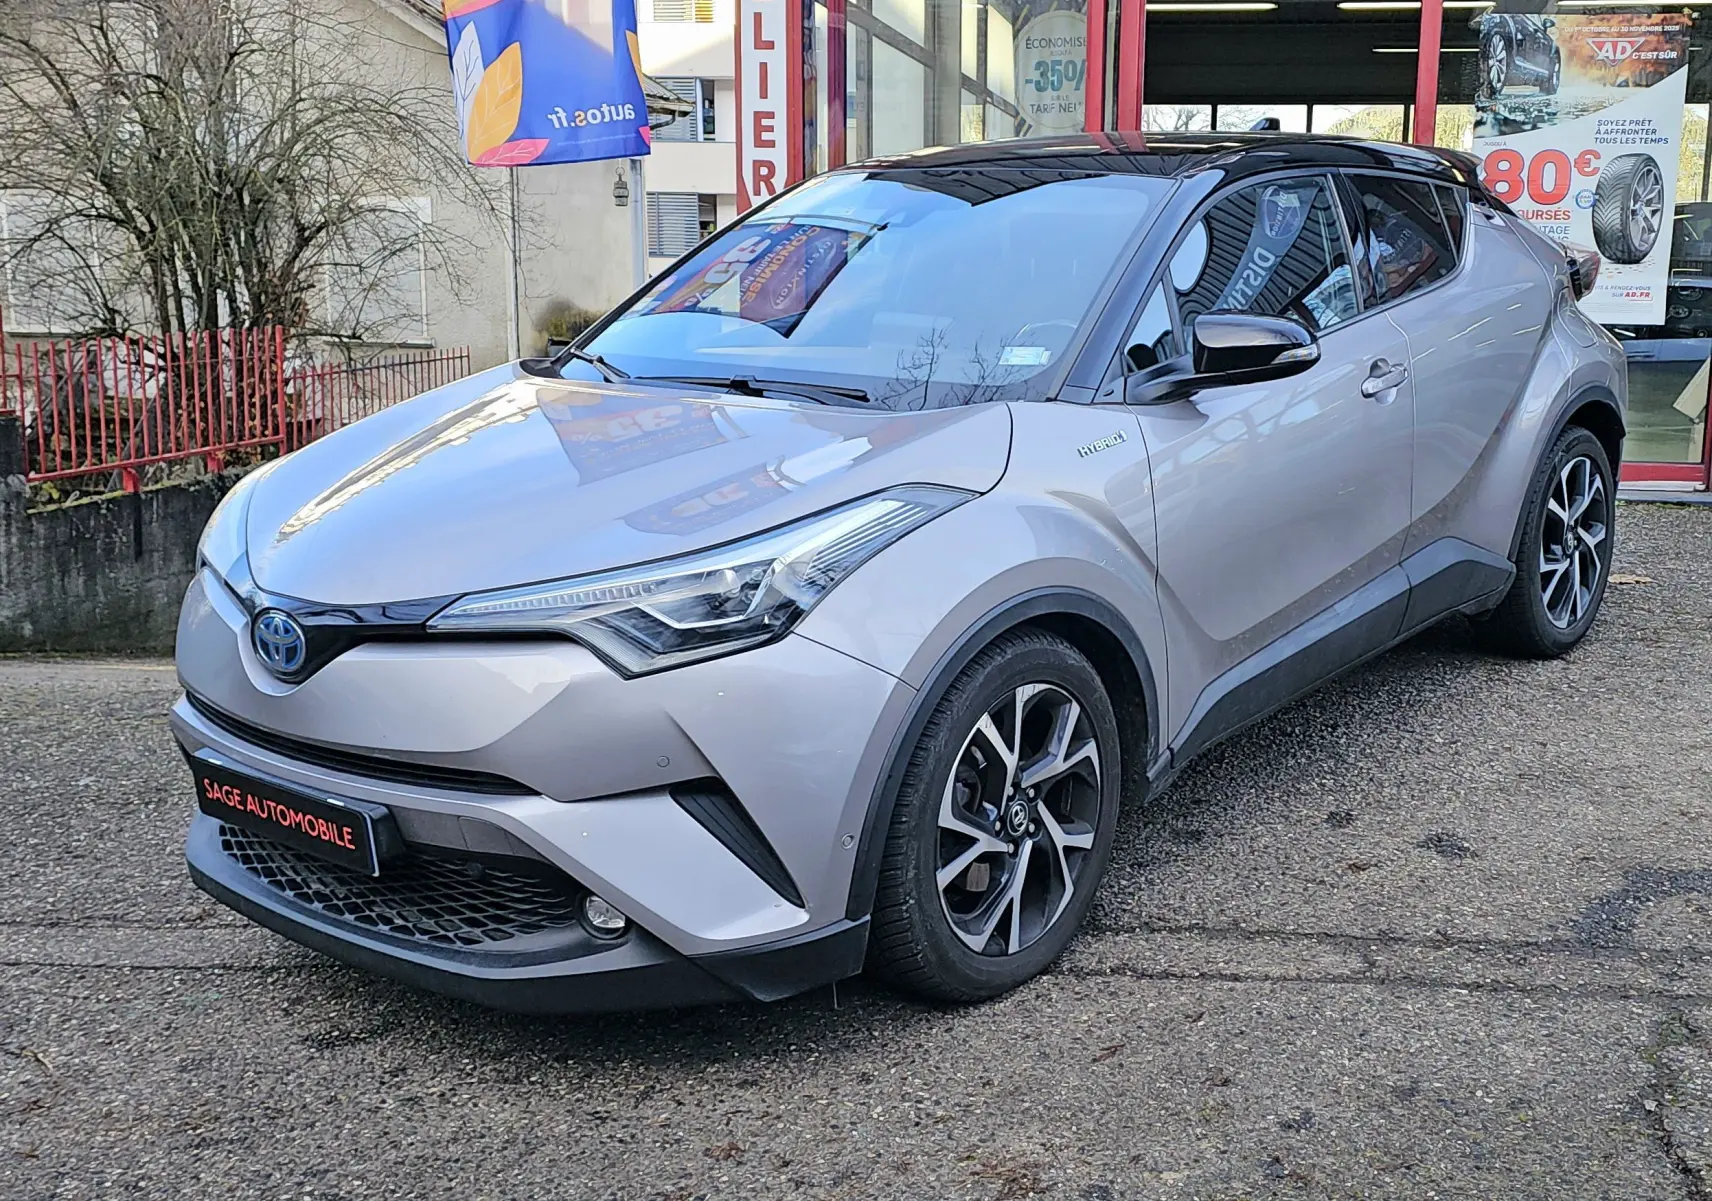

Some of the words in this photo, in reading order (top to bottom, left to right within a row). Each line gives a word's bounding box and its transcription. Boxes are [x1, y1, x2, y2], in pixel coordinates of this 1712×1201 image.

[1598, 41, 1632, 60] AD
[1632, 51, 1657, 59] C'EST
[1658, 50, 1677, 59] SÛR
[753, 12, 776, 196] LIER
[1029, 103, 1055, 114] TARIF
[1597, 119, 1627, 127] SOYEZ
[1628, 118, 1653, 127] PRÊT
[1595, 127, 1601, 136] À
[1603, 128, 1657, 136] AFFRONTER
[1517, 207, 1571, 220] OURSÉS
[1540, 225, 1571, 235] TAGE
[1077, 432, 1122, 458] HYBRID
[203, 778, 244, 810] SAGE
[246, 793, 356, 849] AUTOMOBILE
